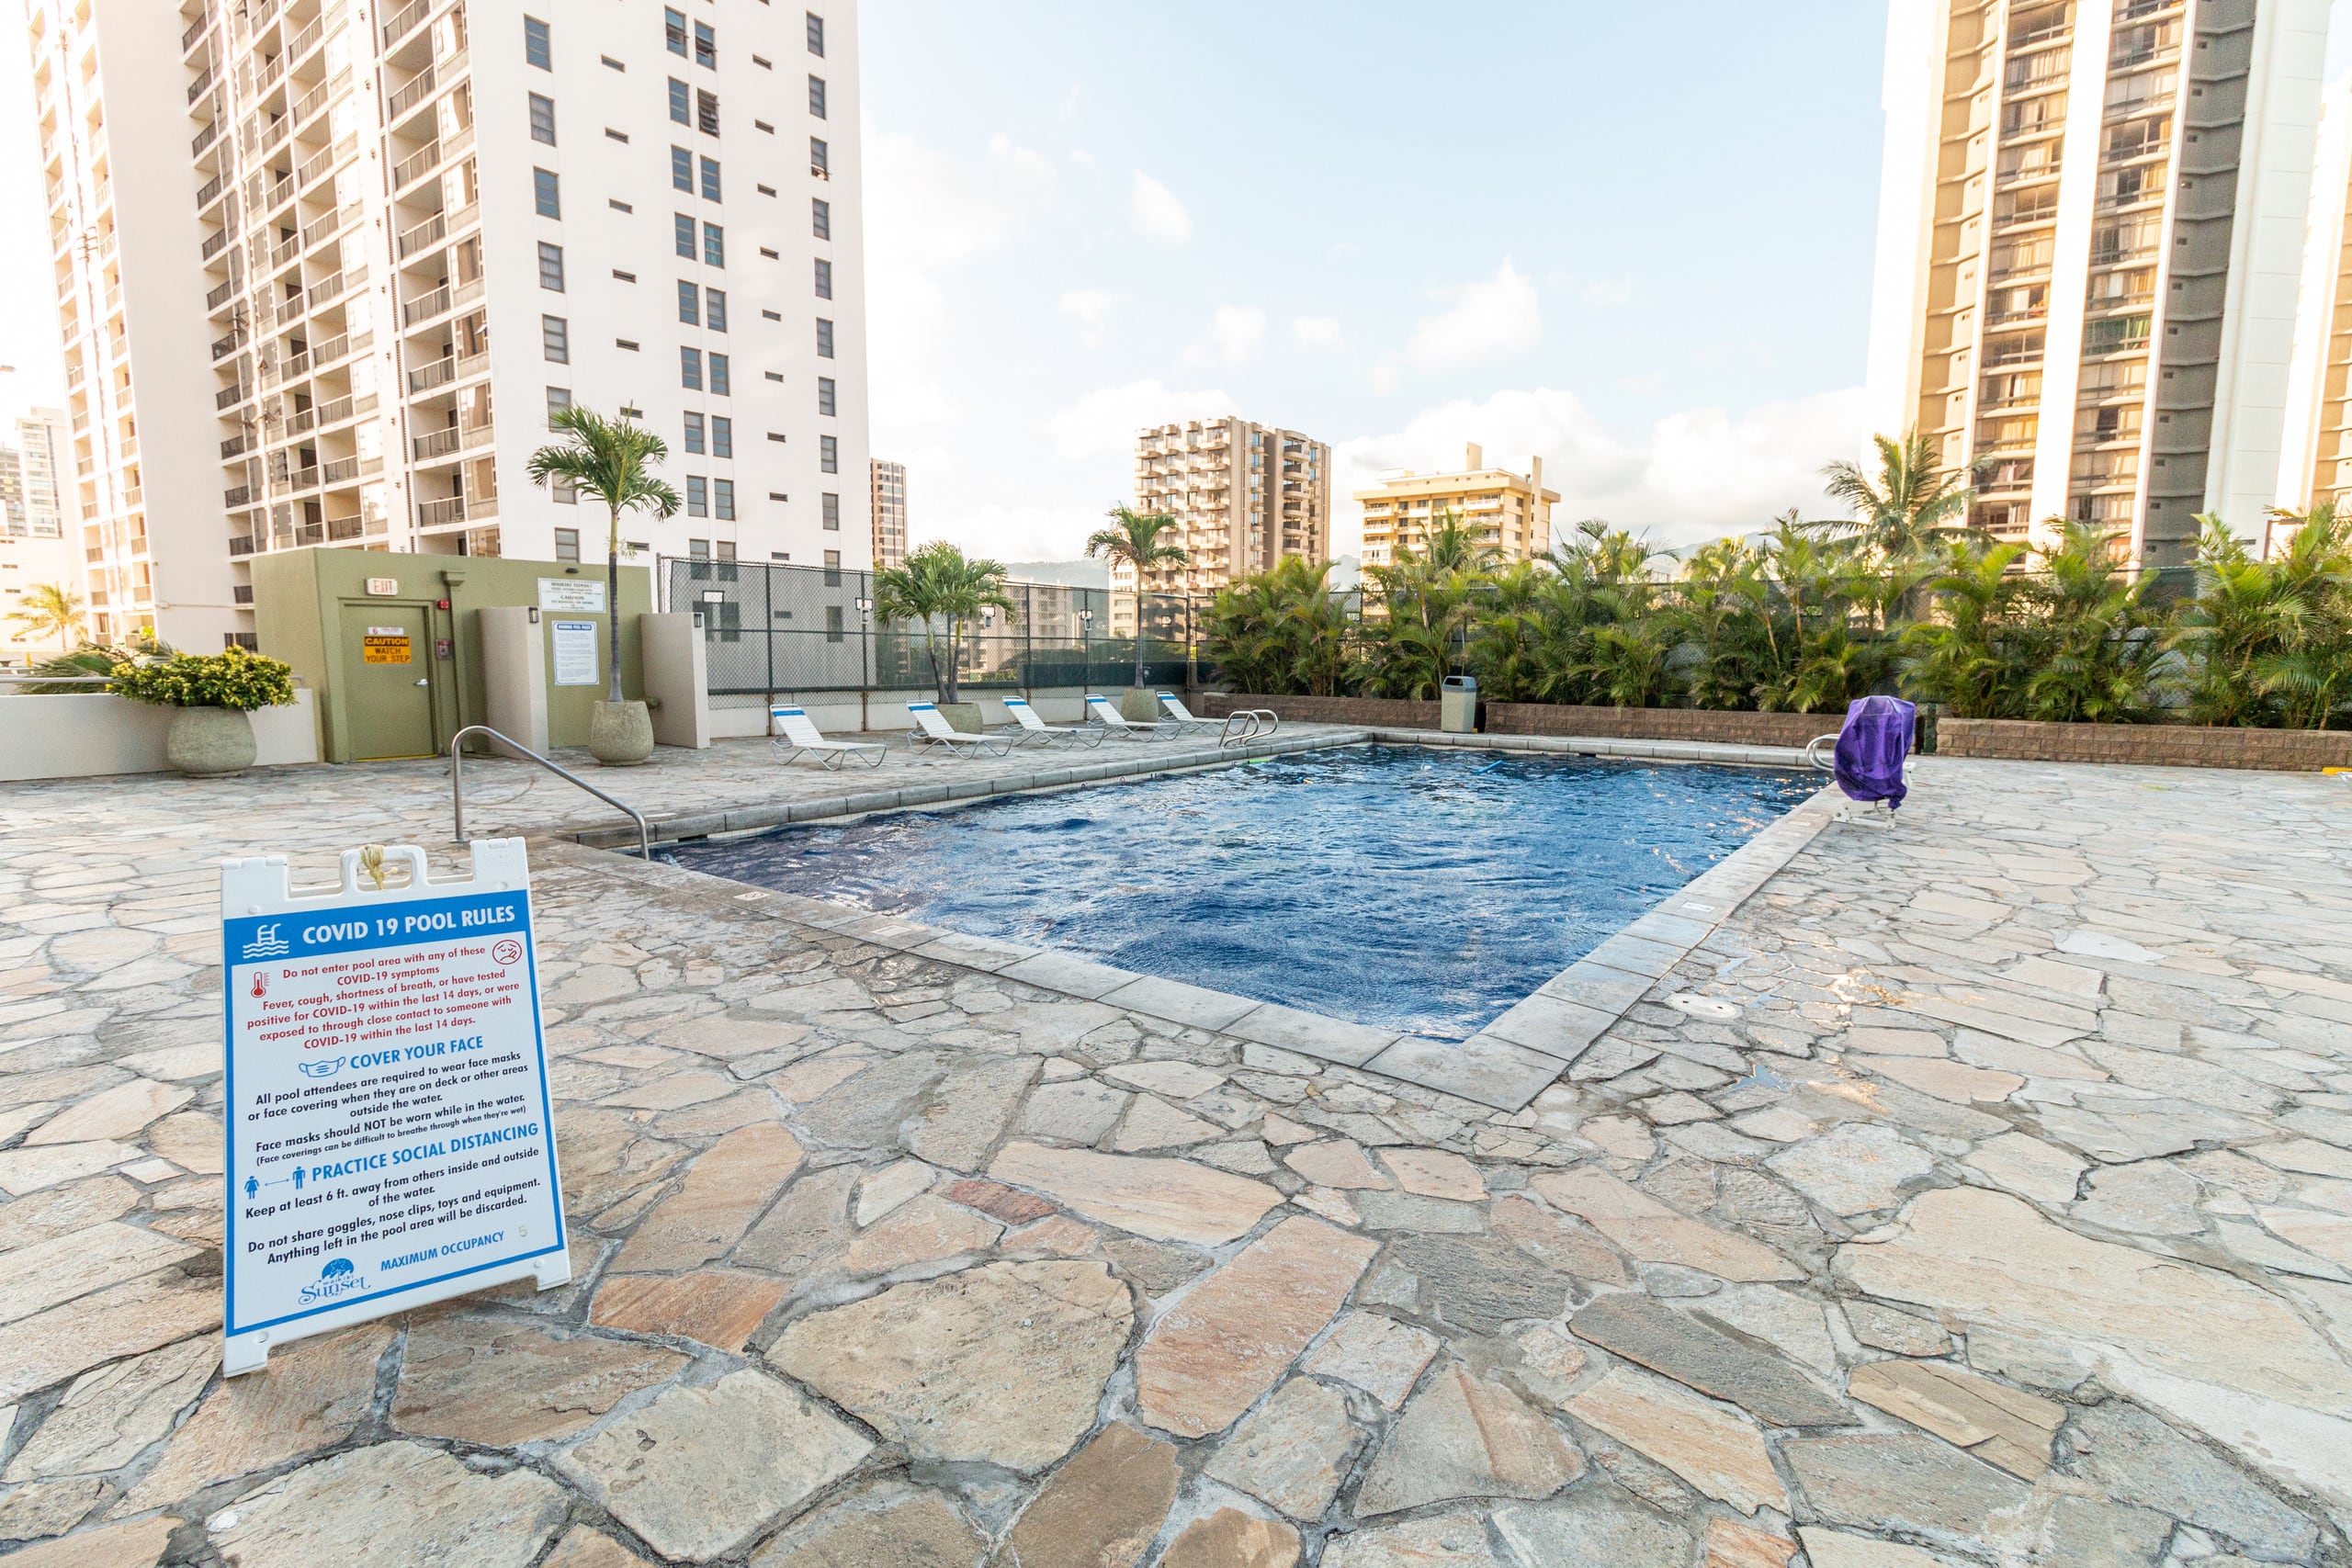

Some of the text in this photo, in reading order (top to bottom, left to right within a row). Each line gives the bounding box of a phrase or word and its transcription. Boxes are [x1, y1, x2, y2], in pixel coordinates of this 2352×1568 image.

[373, 580, 393, 593] EXIT
[302, 905, 515, 944] COVID 19 POOL RULES
[283, 947, 486, 979] Do not enter pool area with any of these
[337, 966, 440, 986] COVID-19 symptoms
[247, 1015, 291, 1031] positive
[294, 1010, 310, 1021] for
[312, 1002, 365, 1019] COVID-19
[368, 998, 400, 1010] within
[402, 996, 419, 1006] the
[422, 993, 439, 1003] last
[443, 989, 455, 1000] 14
[457, 988, 482, 998] days,
[496, 983, 520, 992] were
[263, 1000, 295, 1010] Fever,
[298, 992, 333, 1006] cough,
[335, 987, 385, 1001] shortness
[387, 983, 398, 994] of
[401, 978, 436, 992] breath,
[451, 976, 475, 985] have
[477, 968, 505, 981] tested
[259, 995, 512, 1042] exposed to through close contact to someone with
[303, 1017, 476, 1049] COVID-19 within the last 14 days.
[350, 1035, 483, 1069] COVER YOUR FACE
[247, 1065, 528, 1122] or face covering when they are on deck or other areas
[255, 1051, 521, 1106] All pool attendees are required to wear face masks
[255, 1094, 526, 1153] Face masks should NOT be worn while in the water.
[349, 1094, 443, 1118] outside the water.
[256, 1156, 279, 1168] (Face
[281, 1146, 322, 1160] coverings
[324, 1144, 339, 1152] can
[341, 1140, 352, 1148] be
[354, 1133, 385, 1146] difficult
[397, 1125, 428, 1137] breathe
[429, 1118, 460, 1131] through
[461, 1115, 482, 1124] when
[483, 1110, 509, 1120] they're
[510, 1105, 526, 1114] wet)
[312, 1122, 538, 1182] PRACTICE SOCIAL DISTANCING
[245, 1146, 539, 1219] Keep at least 6 ft. away from others inside and outside
[368, 1186, 435, 1207] of the water.
[248, 1178, 540, 1253] Do not share goggles, nose clips, toys and equipment.
[267, 1193, 527, 1265] Anything left in the pool area will be discarded.
[380, 1224, 528, 1271] MAXIMUM OCCUPANCY 5
[298, 1276, 371, 1305] Sunset
